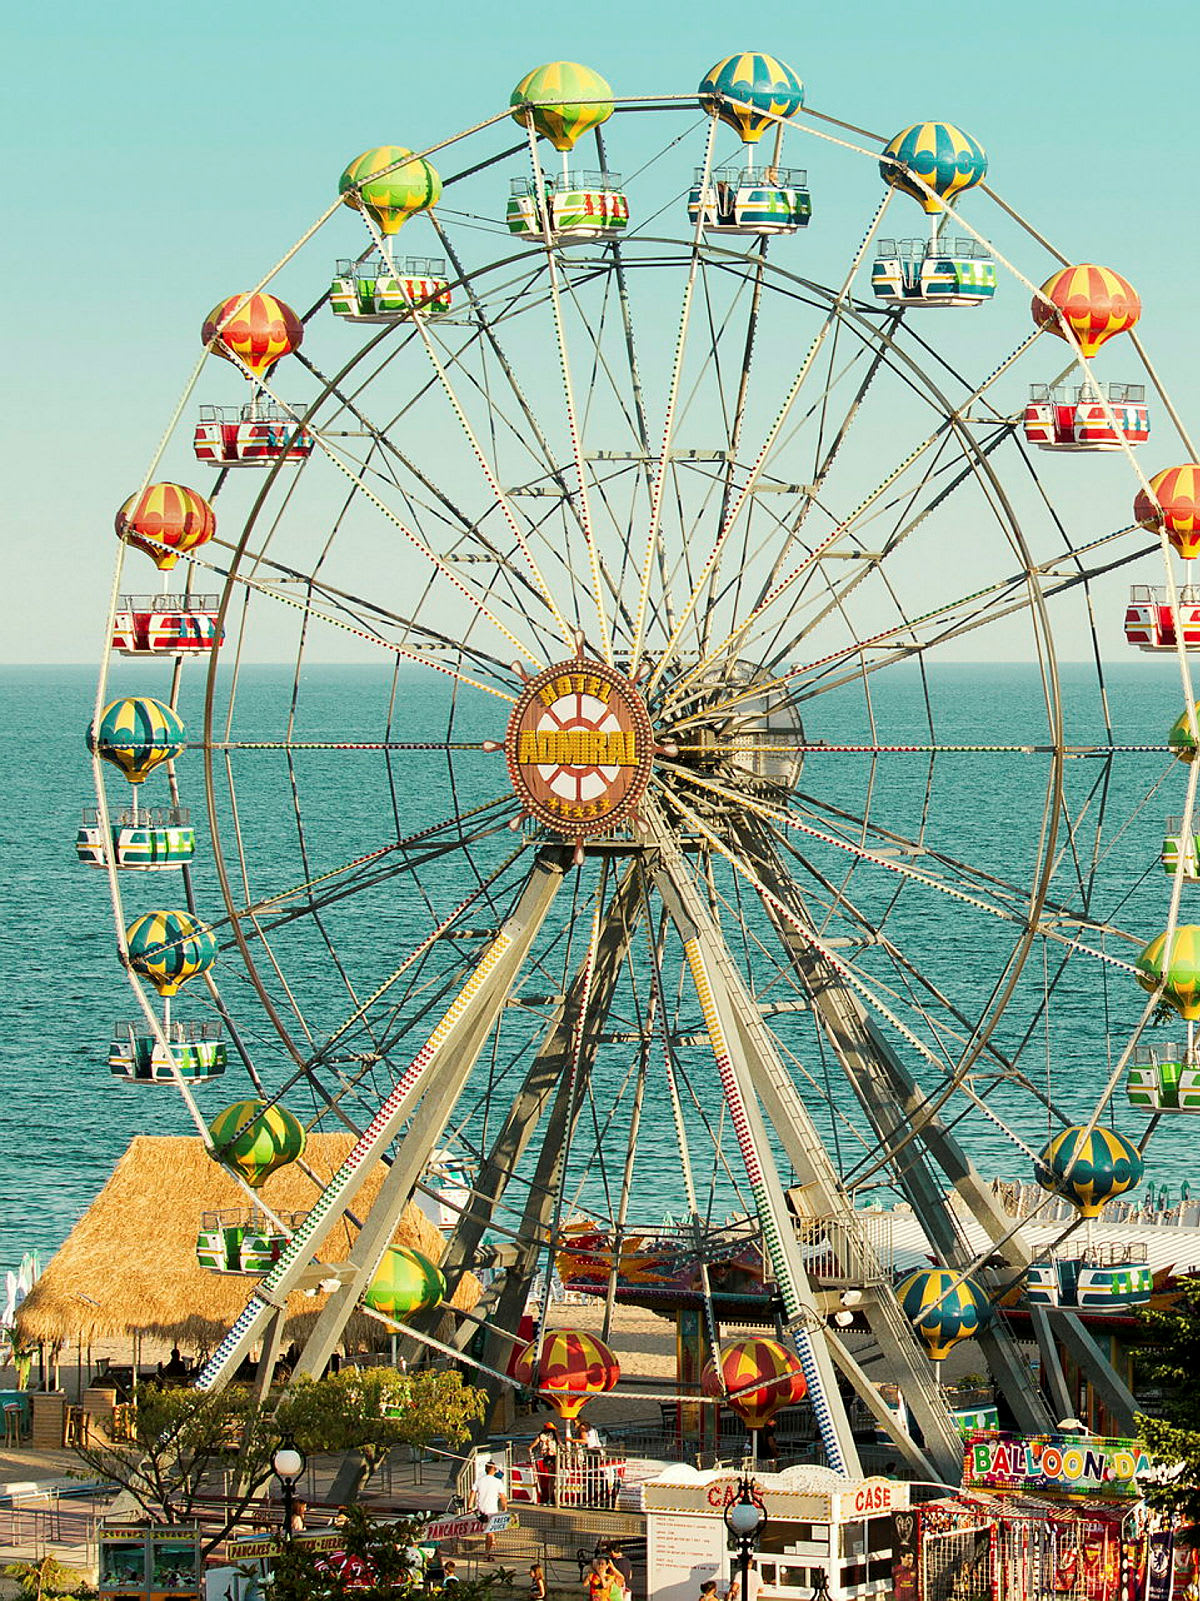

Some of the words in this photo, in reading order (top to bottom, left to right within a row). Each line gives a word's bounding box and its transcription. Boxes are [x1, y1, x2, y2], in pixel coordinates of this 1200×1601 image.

[519, 730, 640, 766] ADMIRAL
[973, 1444, 1105, 1483] BALLOON
[1113, 1451, 1151, 1483] DA
[855, 1486, 891, 1512] CASE
[426, 1521, 469, 1539] PANCAKES
[231, 1543, 271, 1558] PANCAKES
